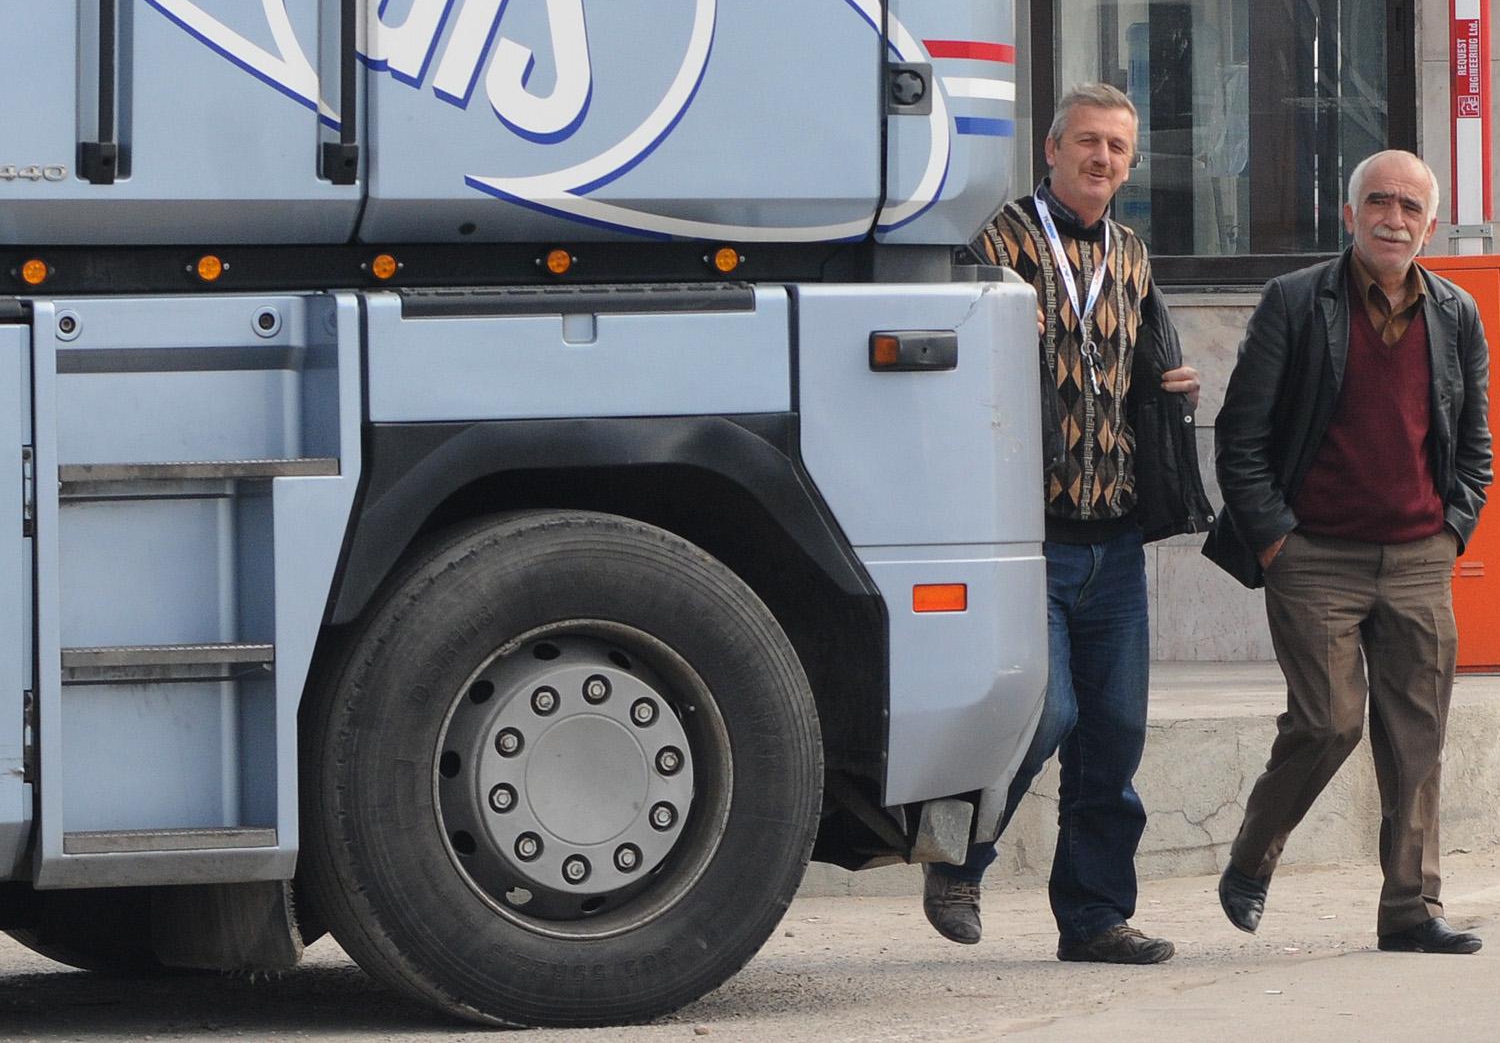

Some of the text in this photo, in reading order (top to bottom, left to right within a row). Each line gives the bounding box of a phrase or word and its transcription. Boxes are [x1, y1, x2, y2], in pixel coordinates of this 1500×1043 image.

[1456, 38, 1468, 76] REQUEST
[1468, 20, 1479, 94] ENGINEERING Ltd.
